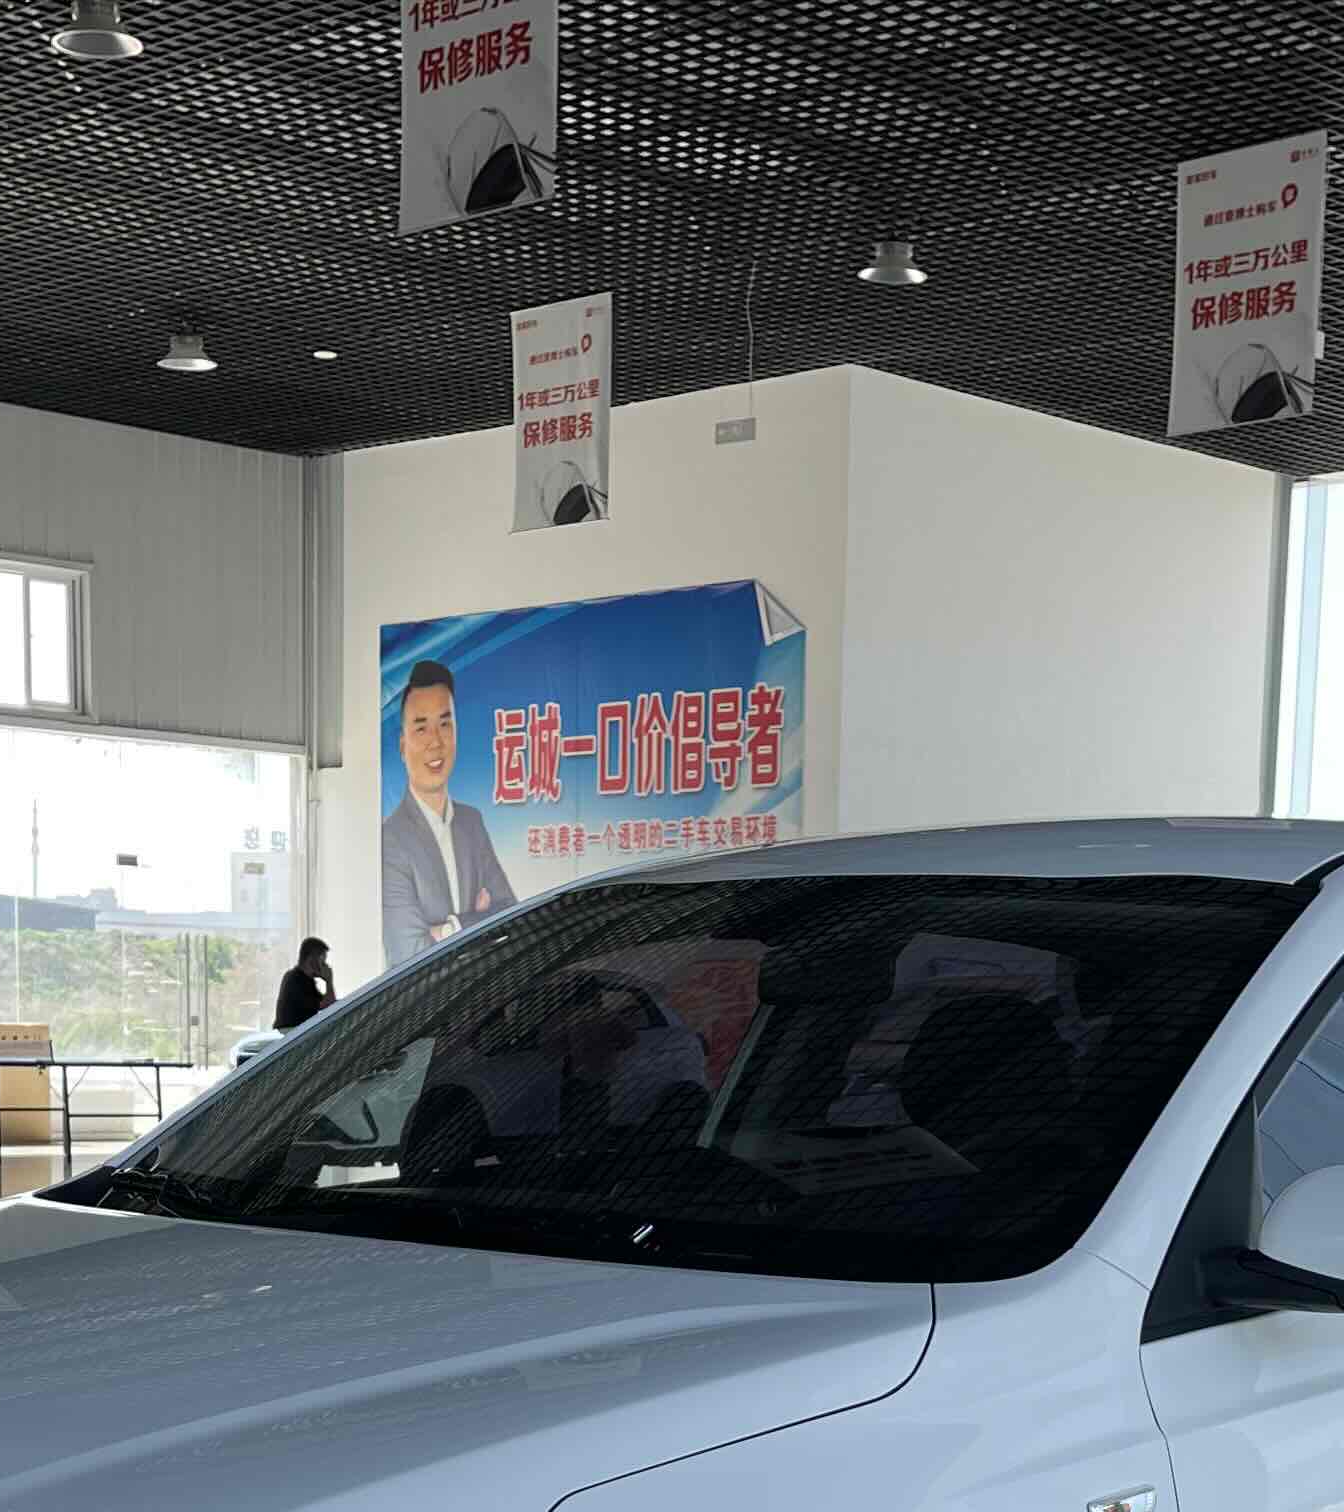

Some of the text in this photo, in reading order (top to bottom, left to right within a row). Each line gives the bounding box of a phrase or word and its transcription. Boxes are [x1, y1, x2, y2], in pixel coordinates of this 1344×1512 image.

[418, 21, 532, 93] 保修服务
[1183, 240, 1308, 284] 1年或三万公里
[1191, 281, 1297, 330] 保修服务
[518, 379, 601, 411] 1年或三万公里
[523, 412, 593, 449] 保修服务
[493, 682, 785, 805] 运城一口价倡导者
[528, 815, 777, 854] 还消费者一个透明的二手车交易环境
